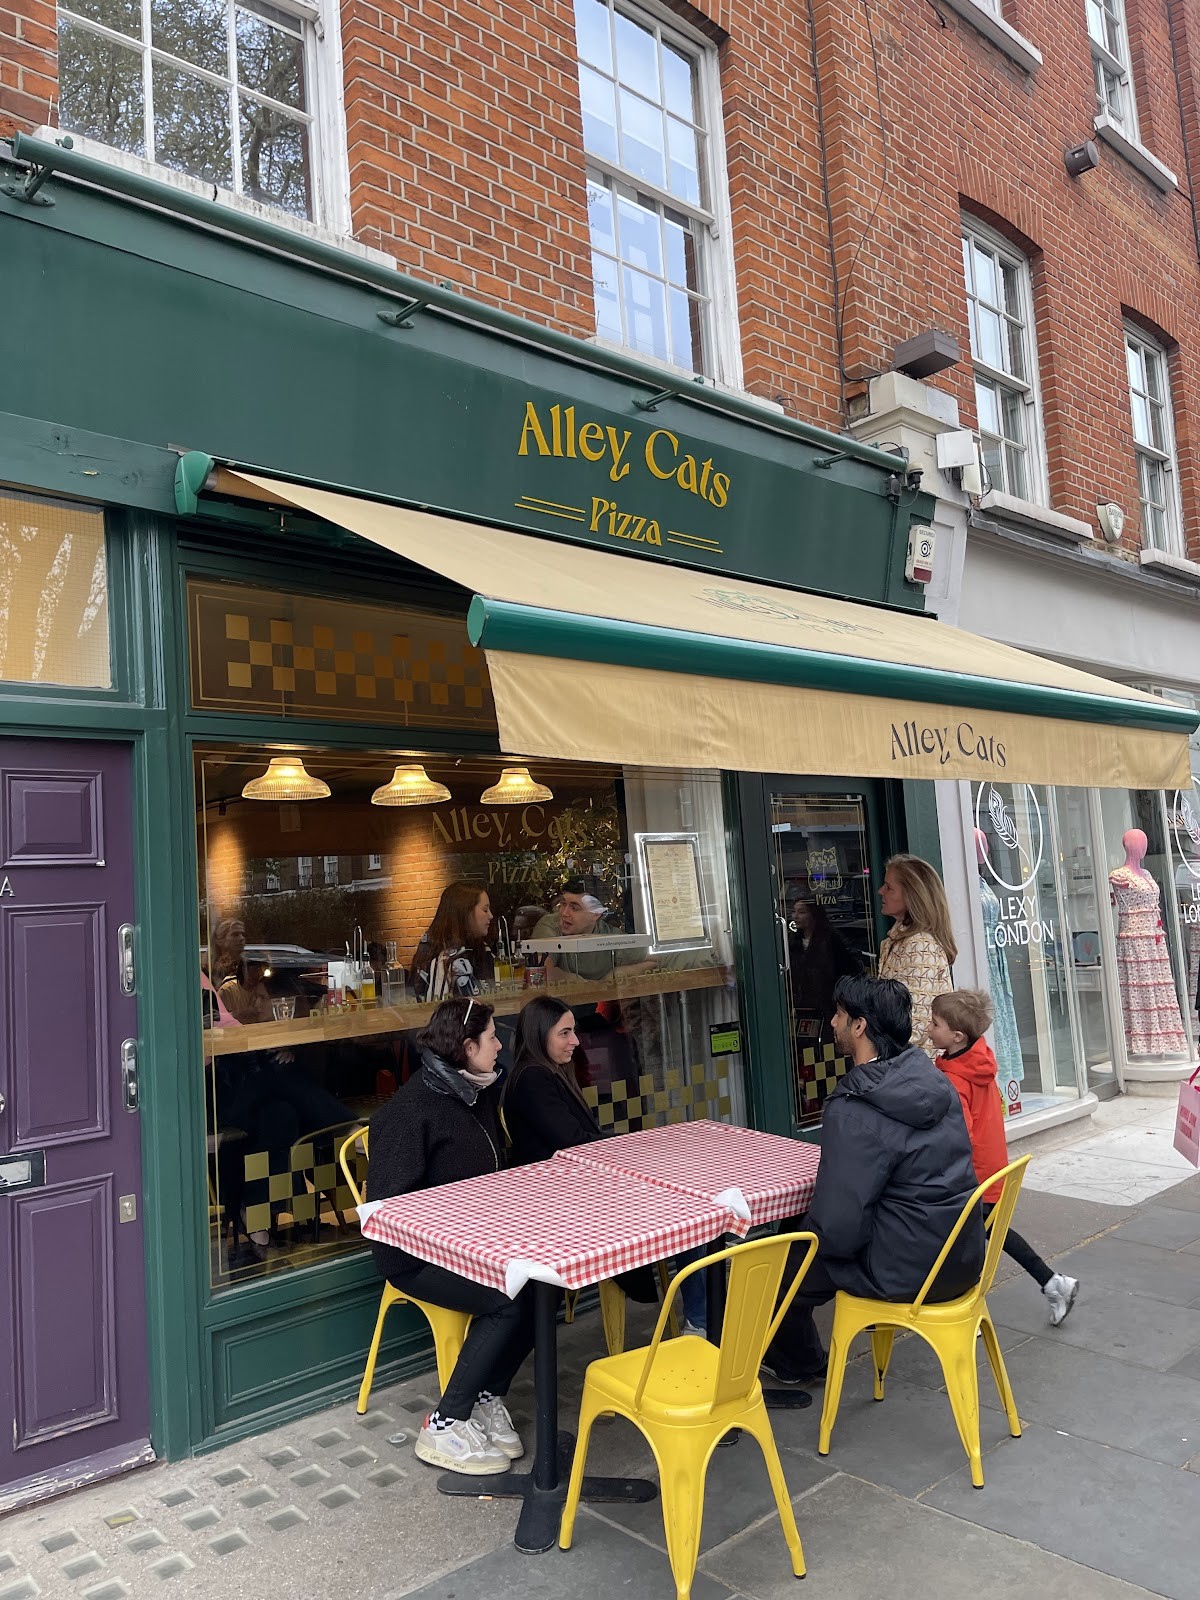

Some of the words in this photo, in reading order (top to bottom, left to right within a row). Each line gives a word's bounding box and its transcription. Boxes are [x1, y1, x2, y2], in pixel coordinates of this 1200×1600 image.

[518, 401, 632, 482] Alley
[645, 429, 731, 508] Cats
[589, 496, 663, 546] Pizza
[891, 720, 951, 765] Alley
[957, 722, 1006, 768] Cats
[431, 806, 512, 848] Alley
[521, 804, 590, 848] Cats
[0, 876, 16, 897] A
[487, 861, 544, 884] Pizza
[815, 894, 837, 905] Pizza
[999, 895, 1036, 921] LEXY
[986, 919, 1054, 949] LONDON
